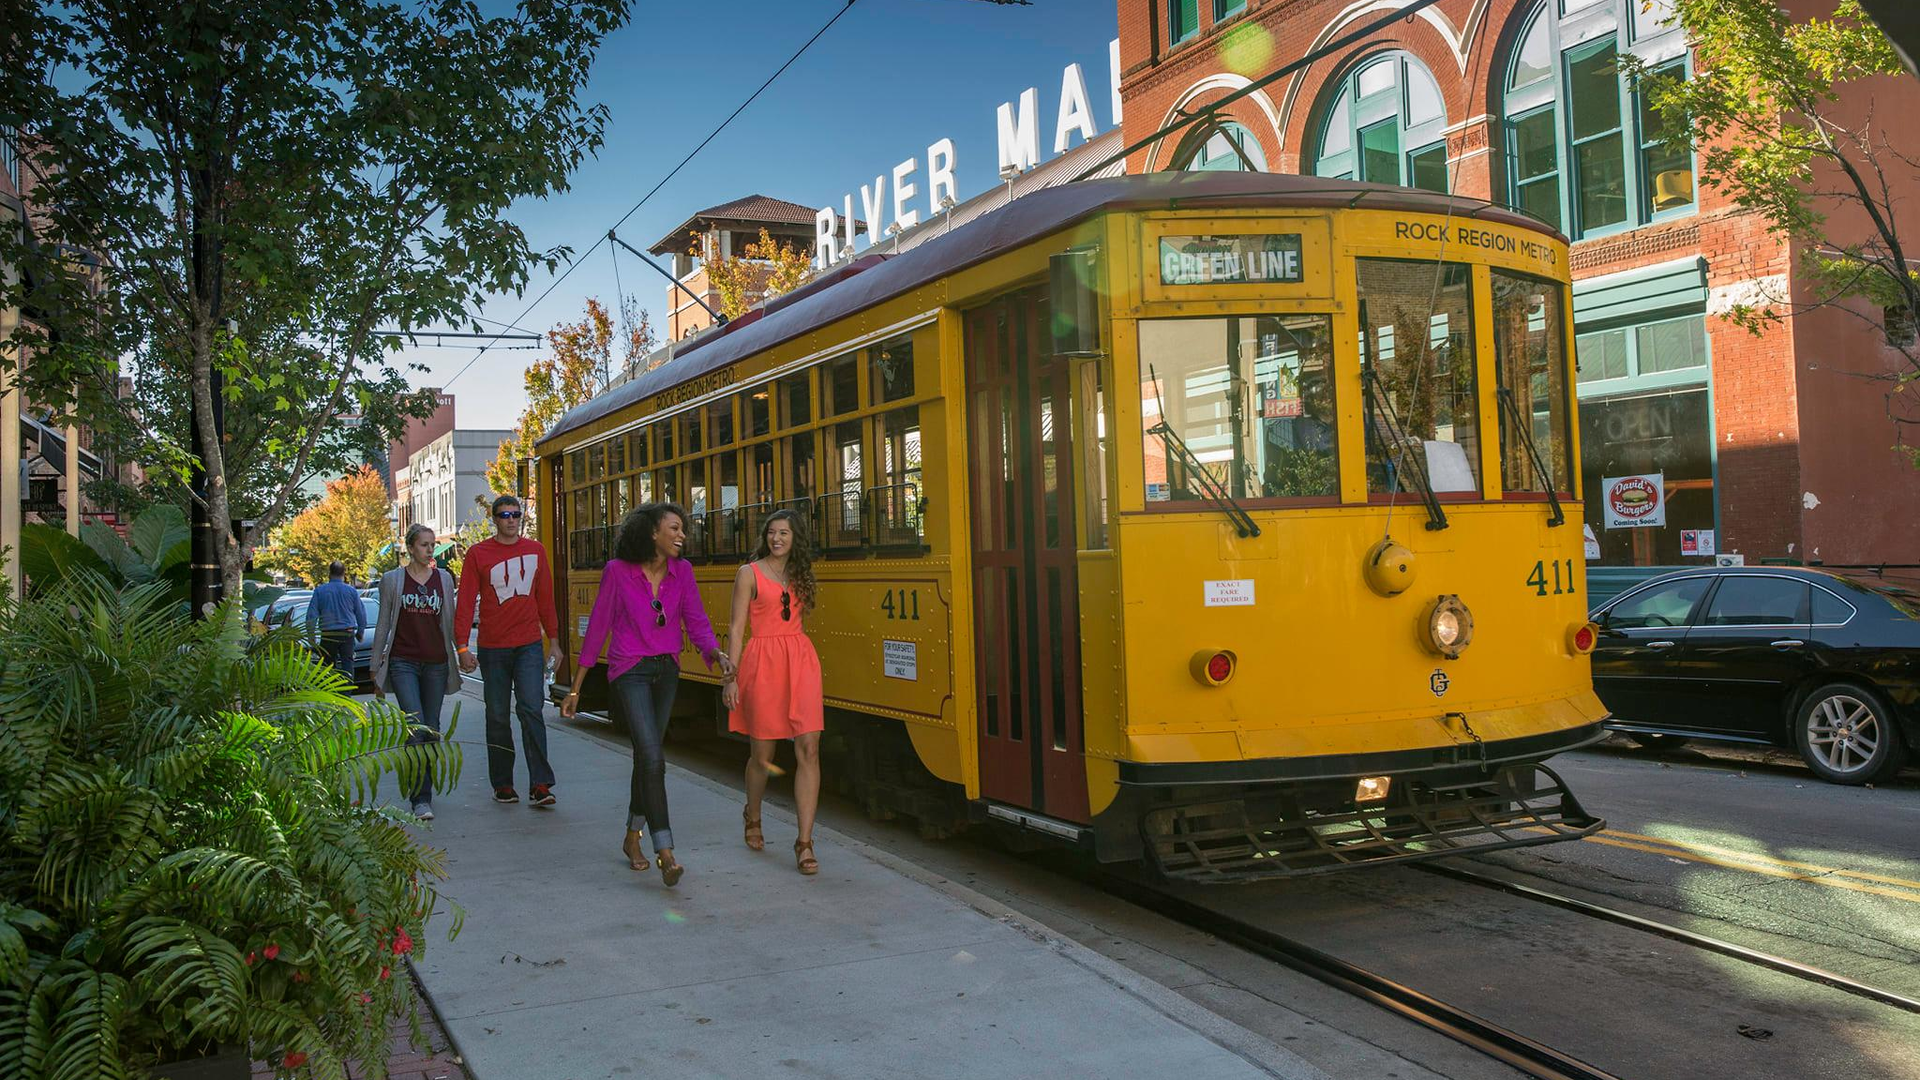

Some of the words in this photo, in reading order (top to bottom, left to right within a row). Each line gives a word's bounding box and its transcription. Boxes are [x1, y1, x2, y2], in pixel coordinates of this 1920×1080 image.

[814, 137, 959, 271] RIVER
[1395, 221, 1450, 243] ROCK
[1458, 227, 1515, 254] REGION
[1520, 239, 1557, 265] METRO
[1164, 251, 1240, 281] GREEN
[1247, 250, 1299, 279] LINE
[656, 392, 675, 411] ROCK
[676, 380, 705, 403] REGION
[705, 366, 735, 392] METRO
[1615, 480, 1654, 496] David's
[1614, 501, 1654, 517] Burgers
[490, 553, 539, 606] W
[1526, 558, 1575, 597] 411
[881, 588, 920, 620] 411
